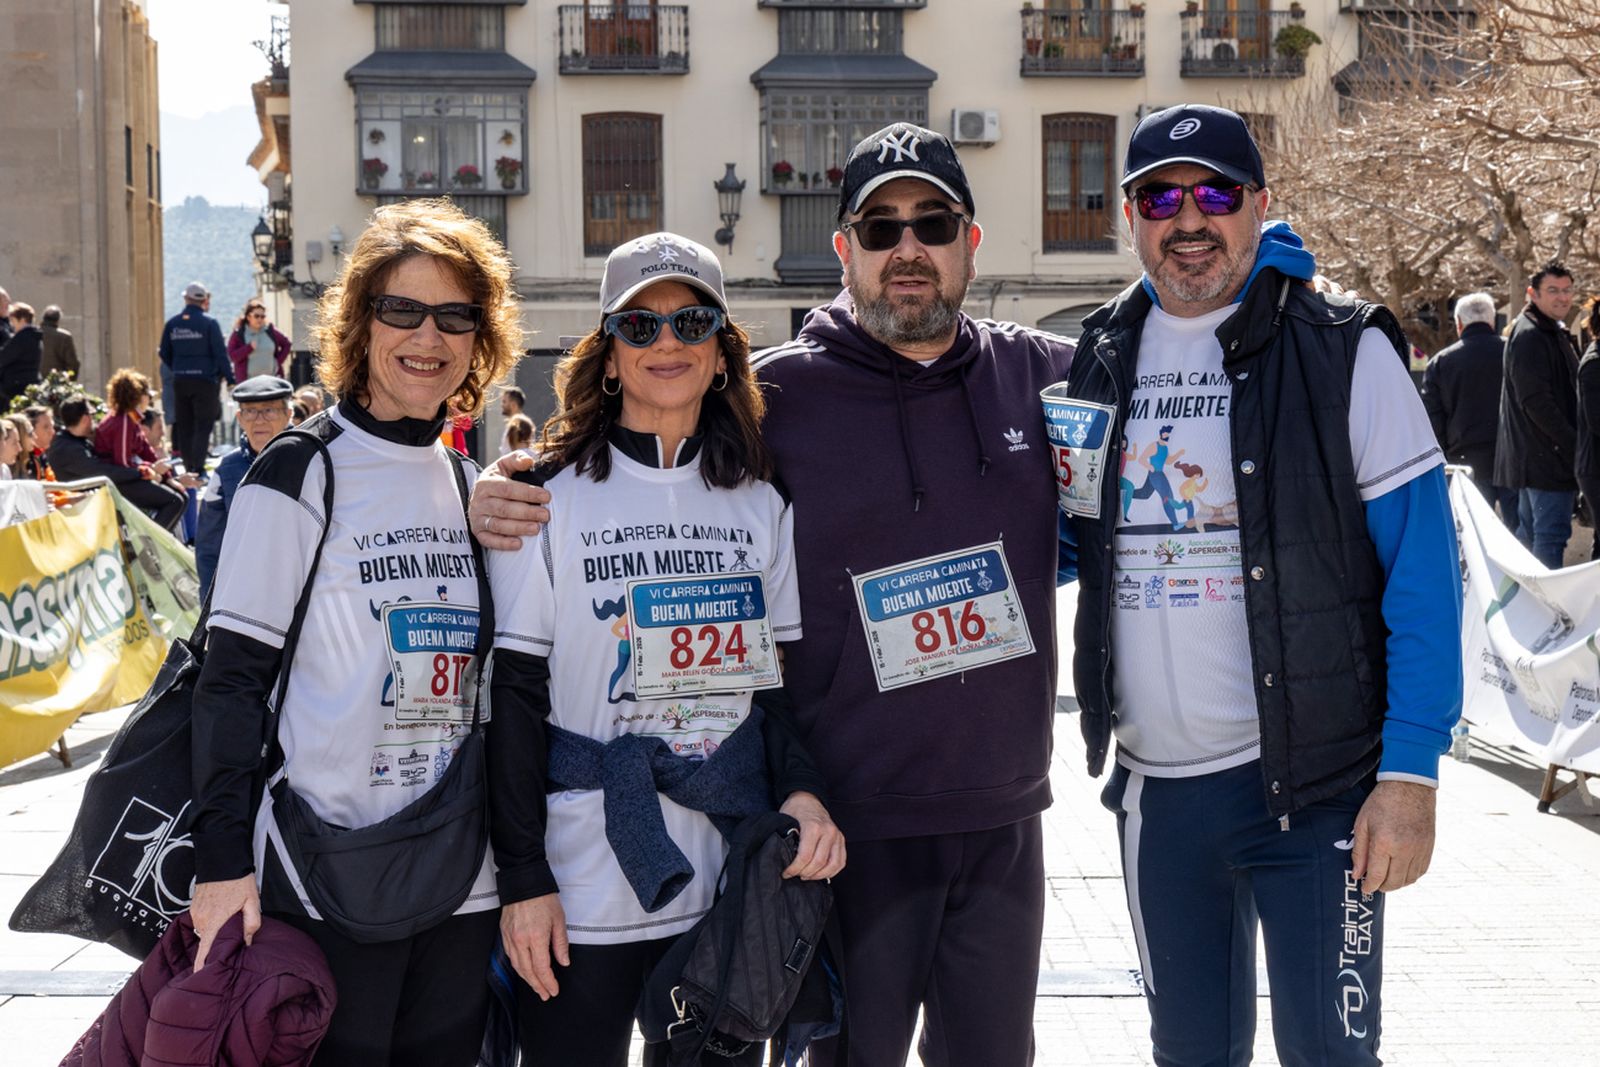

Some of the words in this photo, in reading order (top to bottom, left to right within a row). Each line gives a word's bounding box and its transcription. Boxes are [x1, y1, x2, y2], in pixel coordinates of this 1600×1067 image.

[640, 263, 668, 276] POLO
[671, 263, 700, 278] TEAM
[1132, 371, 1183, 391] ARRERA
[1048, 407, 1092, 423] CAMINATA
[1154, 395, 1229, 420] MUERTE
[1008, 443, 1030, 452] adidas
[353, 534, 370, 551] VI
[373, 526, 439, 548] CARRERA
[580, 531, 597, 547] VI
[601, 523, 677, 545] CARRERA
[681, 524, 754, 546] CAMINATA
[1187, 545, 1241, 555] ASPERGER-TE
[358, 553, 423, 585] BUENA
[583, 551, 649, 584] BUENA
[654, 550, 726, 576] MUERTE
[878, 582, 889, 593] VI
[890, 568, 940, 589] CARRERA
[941, 556, 988, 577] CAMINATA
[649, 589, 661, 599] VI
[662, 585, 711, 598] CARRERA
[712, 582, 753, 595] CAMINATA
[881, 590, 924, 614] BUENA
[925, 577, 974, 603] MUERTE
[405, 613, 418, 625] VI
[419, 613, 457, 625] CARRERA
[650, 603, 692, 622] BUENA
[694, 600, 739, 620] MUERTE
[911, 600, 986, 653] 816
[408, 630, 444, 648] BUENA
[446, 630, 476, 650] MUERTE
[669, 623, 748, 670] 824
[85, 878, 149, 919] Buena
[1357, 902, 1374, 955] DAY
